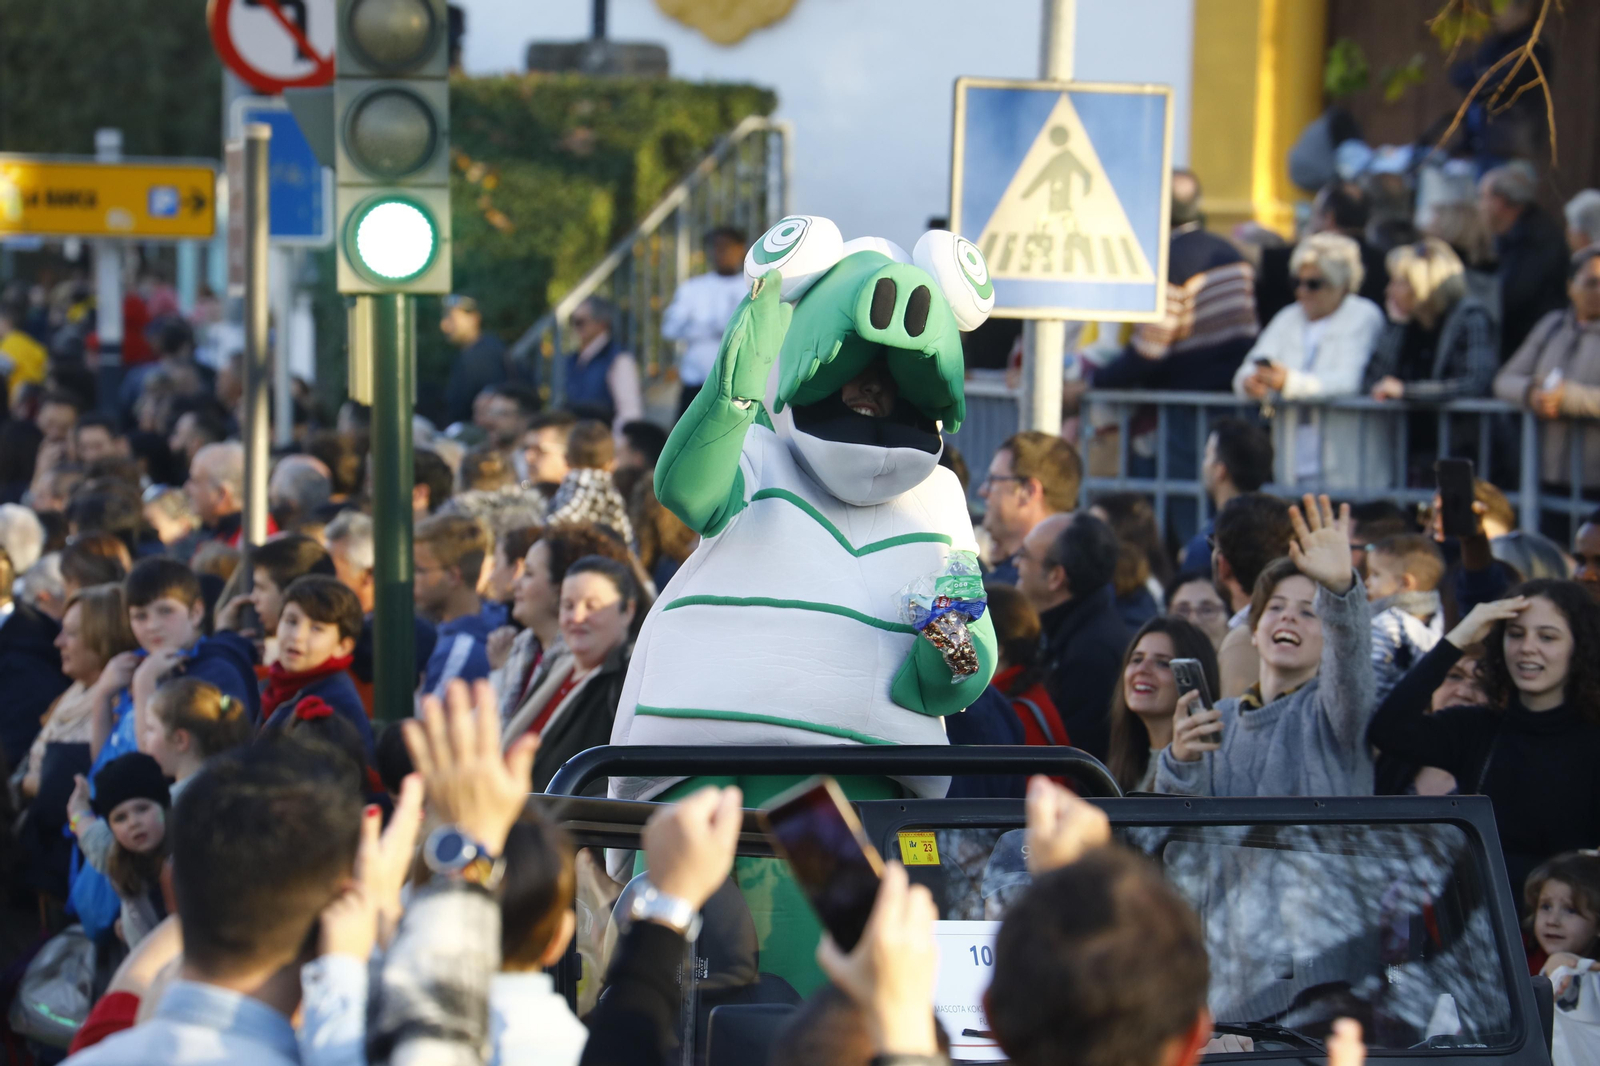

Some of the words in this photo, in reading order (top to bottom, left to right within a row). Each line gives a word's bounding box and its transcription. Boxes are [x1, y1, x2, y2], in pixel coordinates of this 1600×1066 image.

[923, 843, 933, 853] 23
[969, 945, 993, 967] 10
[934, 1005, 966, 1013] MASCOTA
